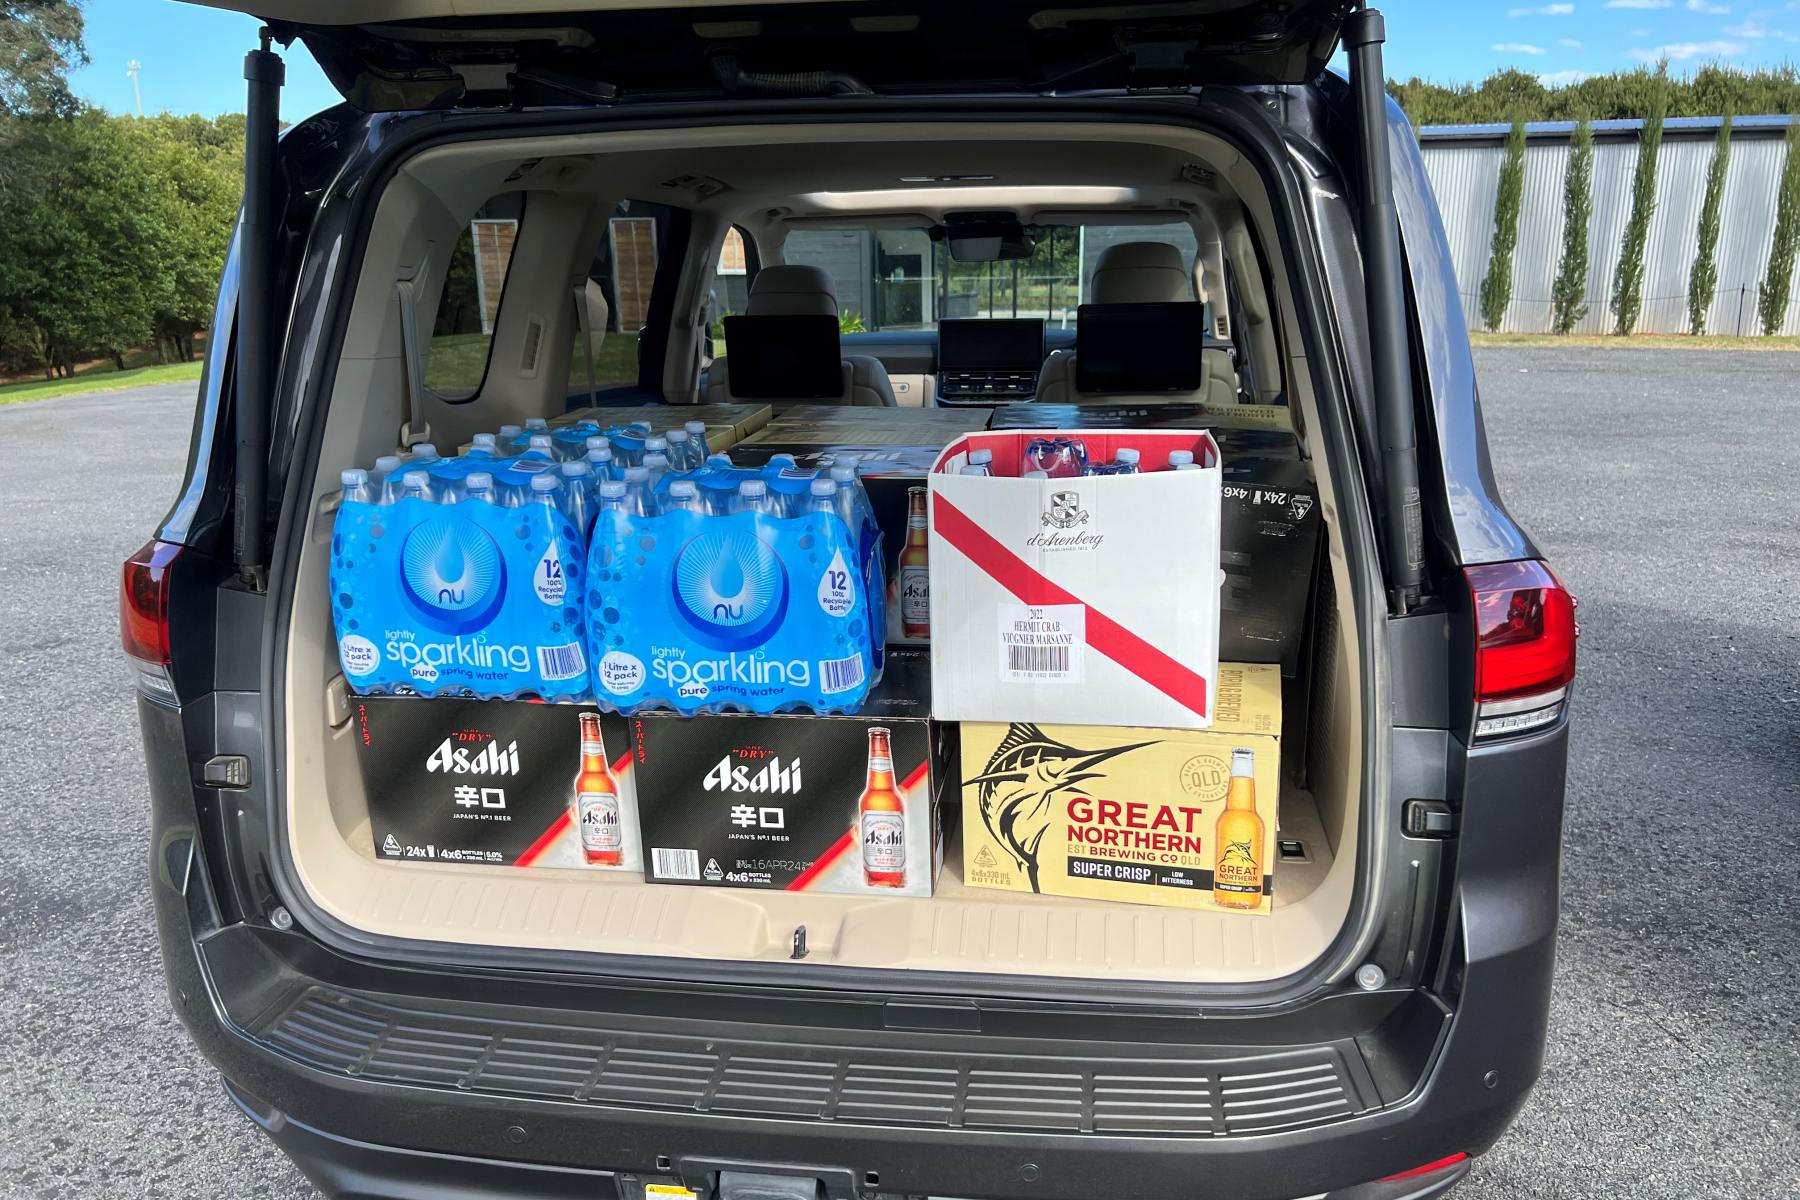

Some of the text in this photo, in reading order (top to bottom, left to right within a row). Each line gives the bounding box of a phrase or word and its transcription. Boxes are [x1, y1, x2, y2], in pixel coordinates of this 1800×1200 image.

[1264, 492, 1287, 505] 24x
[1027, 531, 1104, 549] d'Arenberg
[543, 559, 561, 578] 12
[829, 571, 846, 590] 12
[439, 588, 464, 604] nu
[713, 603, 743, 619] nu
[1030, 608, 1043, 619] 2022
[1014, 621, 1060, 632] HERMIT CRAB
[385, 630, 415, 642] lightly
[1003, 632, 1072, 645] VIOGNIER MARSANNE
[385, 635, 531, 673] sparkling
[651, 646, 685, 660] lightly
[412, 668, 508, 680] pure spring water
[604, 670, 638, 681] 12 pack
[652, 652, 810, 687] sparkling
[680, 684, 785, 697] pure spring water
[426, 737, 520, 776] Asahi
[703, 754, 801, 795] Asahi
[1191, 770, 1221, 787] QLD
[454, 785, 506, 808] 辛口
[582, 810, 617, 825] Asahi
[730, 803, 785, 829] 辛口
[1067, 797, 1202, 833] GREAT
[728, 833, 755, 841] JAPAN'S
[865, 830, 902, 845] Asahi
[1067, 825, 1201, 854] NORTHERN
[406, 846, 426, 857] 24x
[440, 849, 462, 859] 4x6
[1067, 844, 1086, 854] EST
[1090, 846, 1156, 861] BREWING
[1181, 855, 1200, 866] QLD
[725, 872, 748, 882] 4x6
[1073, 861, 1151, 881] SUPER CRISP
[1219, 864, 1257, 875] GREAT
[1219, 873, 1257, 881] NORTHERN
[1161, 877, 1193, 886] BITTERNESS
